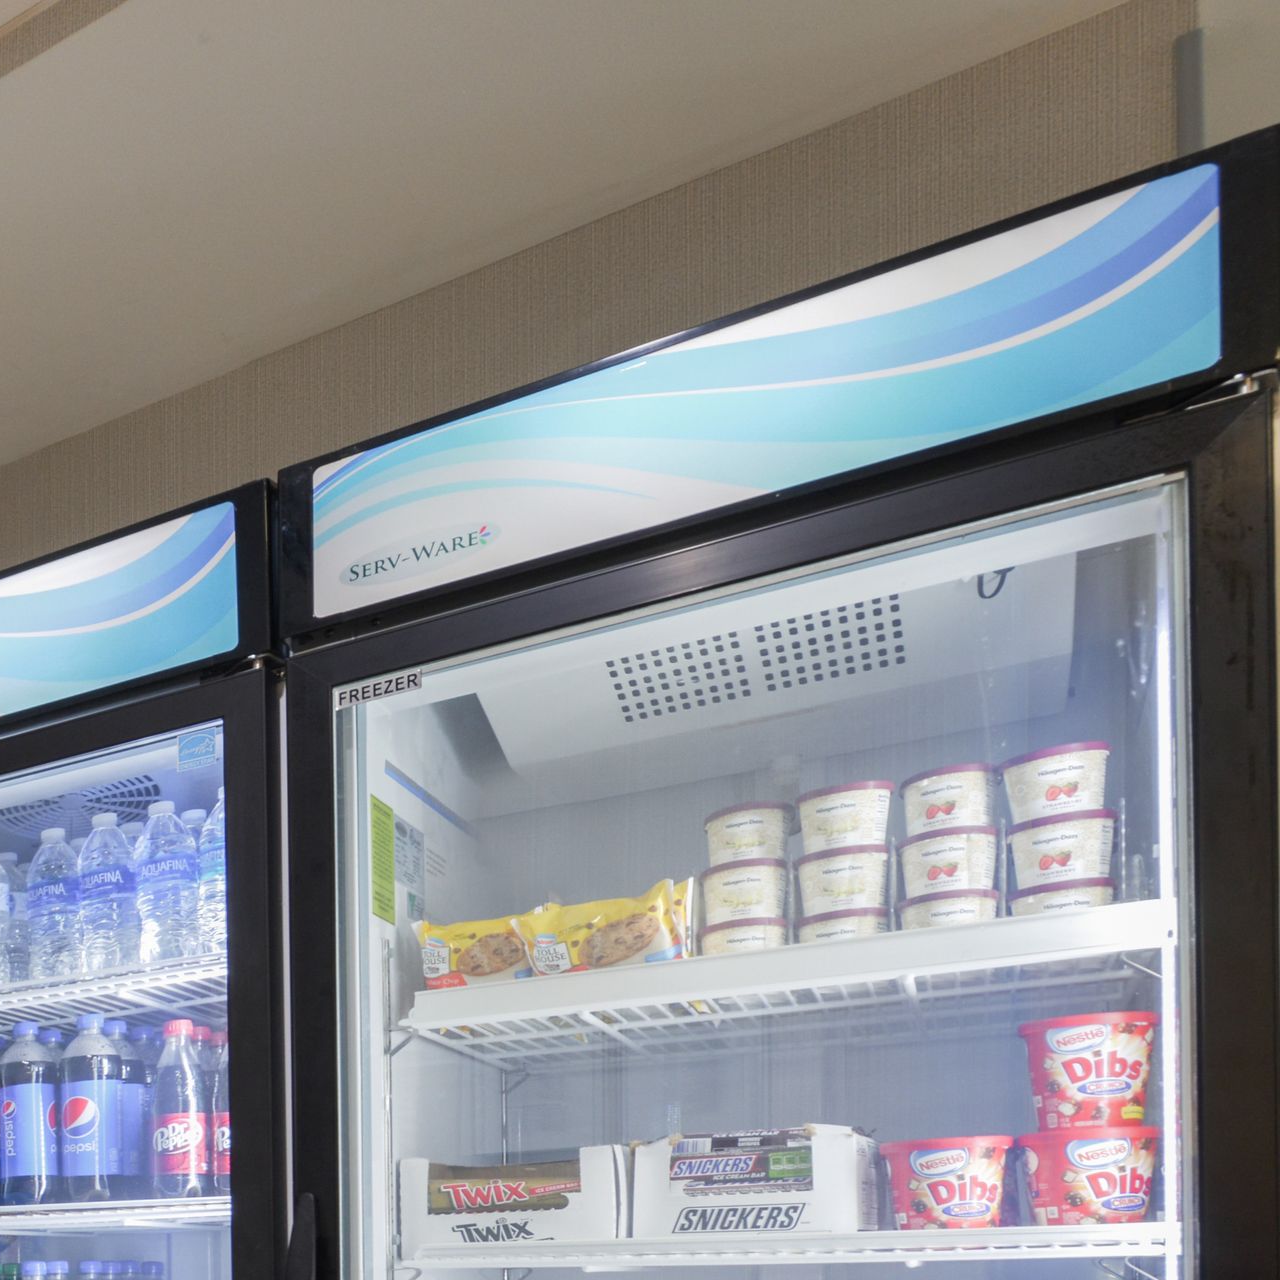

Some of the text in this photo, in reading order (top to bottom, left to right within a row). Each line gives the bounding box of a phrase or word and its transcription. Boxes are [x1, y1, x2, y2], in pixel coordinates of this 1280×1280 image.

[349, 531, 478, 582] SERV-WARE
[338, 673, 419, 706] FREEZER
[141, 858, 190, 879] AQUAFINA
[1060, 1049, 1145, 1085] Dibs
[5, 1121, 17, 1157] pepsi
[63, 1140, 100, 1155] pepsi
[673, 1156, 753, 1176] SNICKERS
[1085, 1166, 1152, 1199] Dibs
[926, 1173, 999, 1206] Dibs
[679, 1204, 799, 1231] SNICKERS
